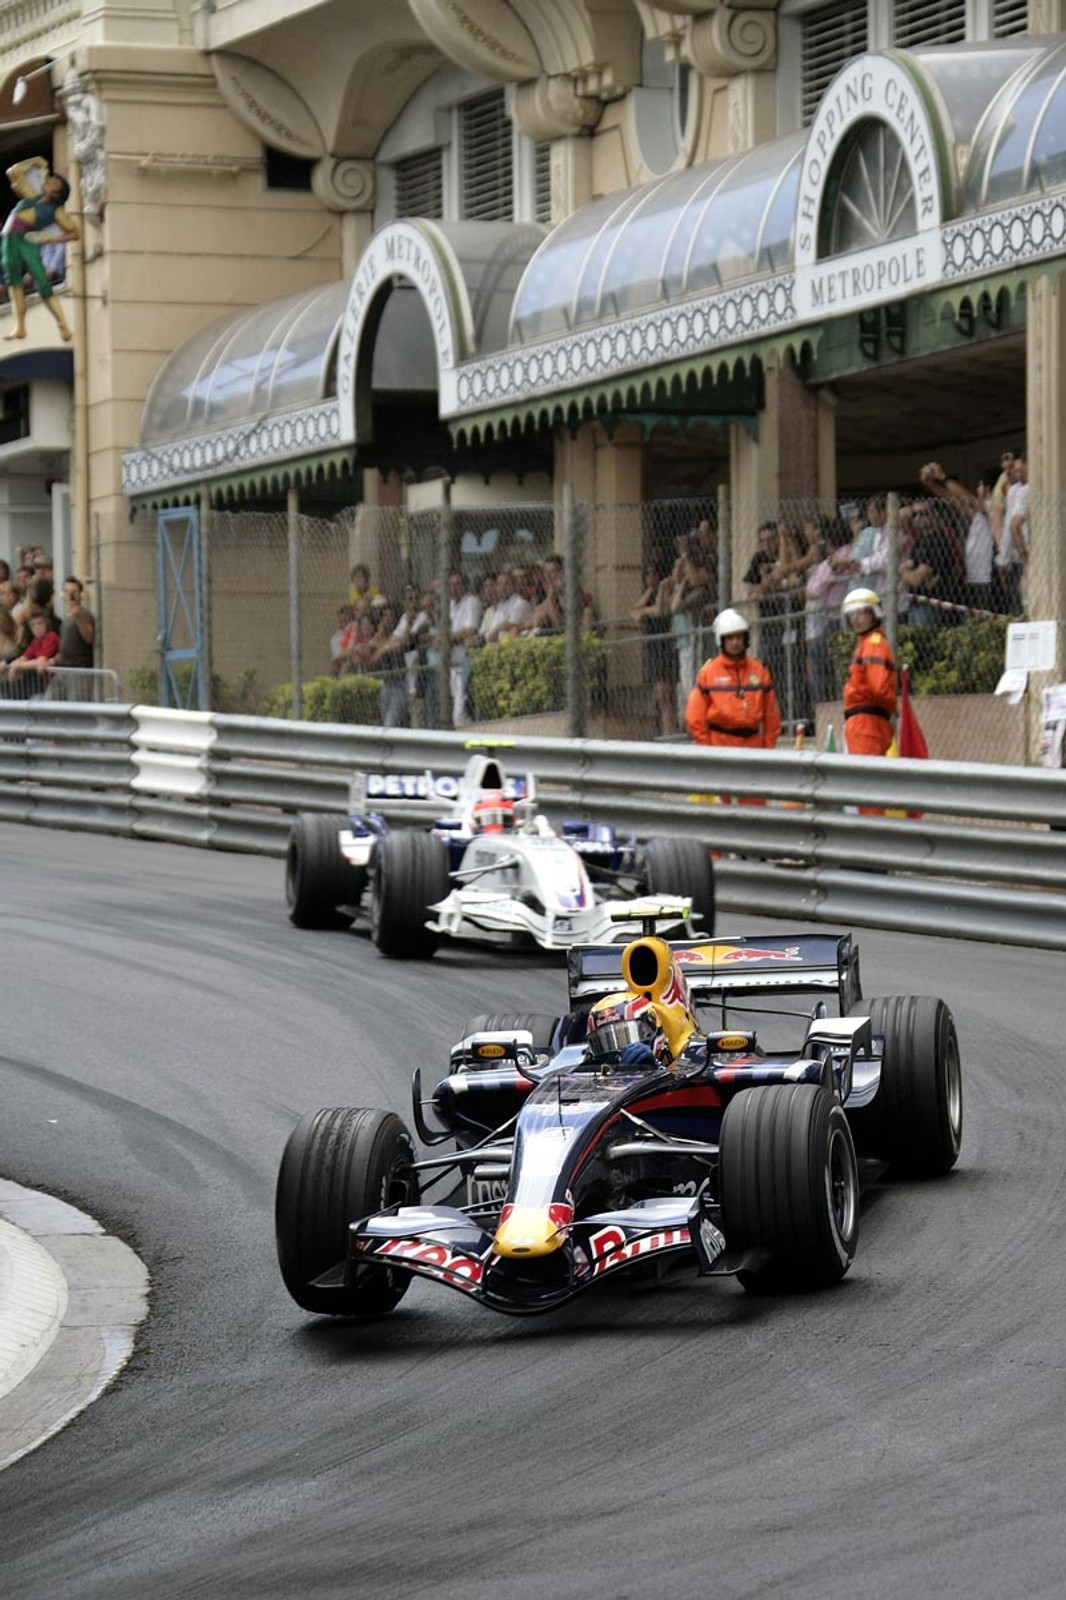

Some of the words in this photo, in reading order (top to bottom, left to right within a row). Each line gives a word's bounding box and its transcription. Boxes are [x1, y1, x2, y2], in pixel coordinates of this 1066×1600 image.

[799, 72, 874, 252] SHOPPING
[884, 78, 934, 218] CENTER
[341, 254, 377, 395] GALERIE
[384, 233, 451, 369] METROPOLE
[810, 246, 927, 308] METROPOLE
